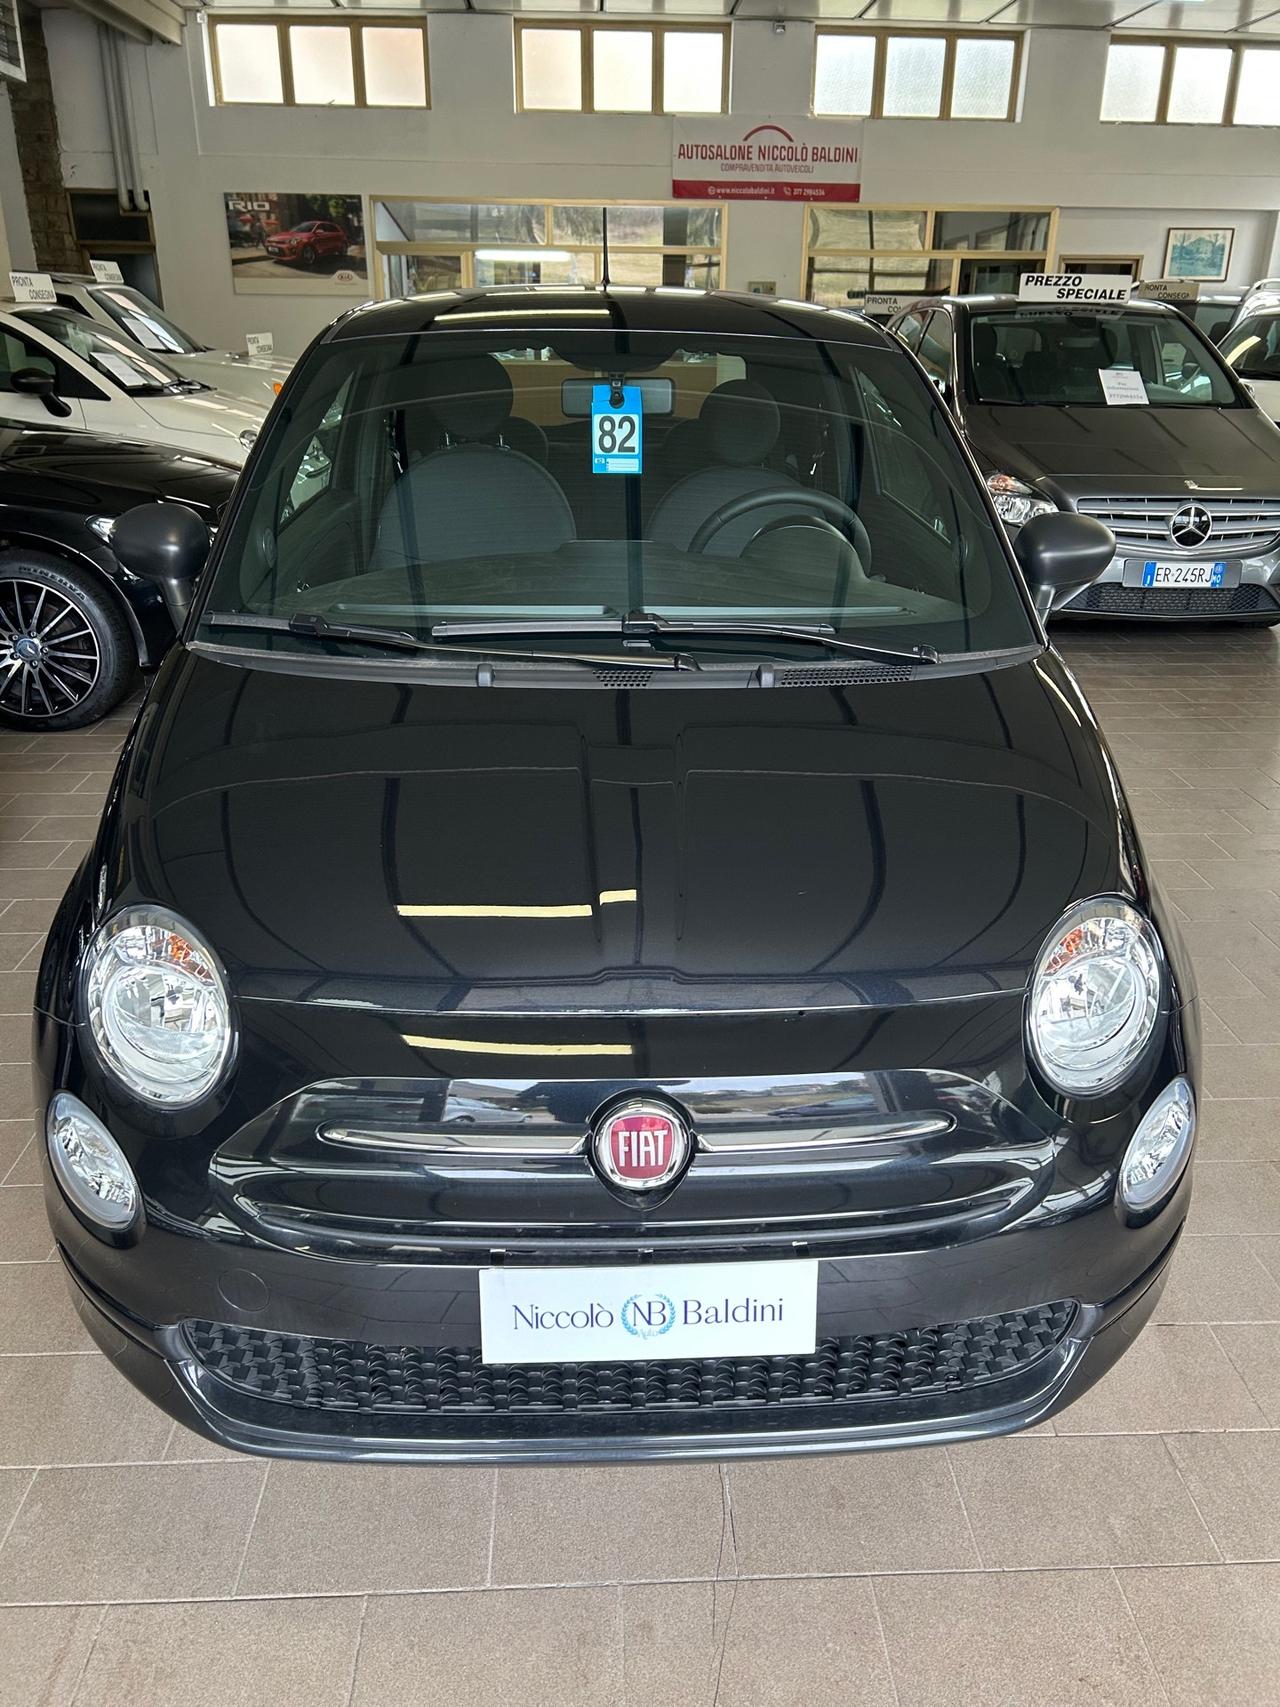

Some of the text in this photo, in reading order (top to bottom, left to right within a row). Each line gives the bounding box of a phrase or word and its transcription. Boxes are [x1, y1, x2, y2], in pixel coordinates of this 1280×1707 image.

[678, 142, 858, 163] AUTOSALONE NICCOLÒ BALDINI
[720, 163, 814, 174] COMPRAVENDITA AUTOVEICOLI
[228, 201, 271, 212] RIO
[12, 275, 34, 288] PRONTA
[1025, 275, 1082, 287] PREZZO
[28, 289, 55, 300] CONSEGNA
[866, 296, 898, 304] PRONTA
[1056, 288, 1127, 300] SPECIALE
[598, 415, 636, 454] 82
[1155, 567, 1172, 583] ER
[618, 1129, 668, 1167] FIAT
[512, 1298, 784, 1330] Niccolò NB Baldini
